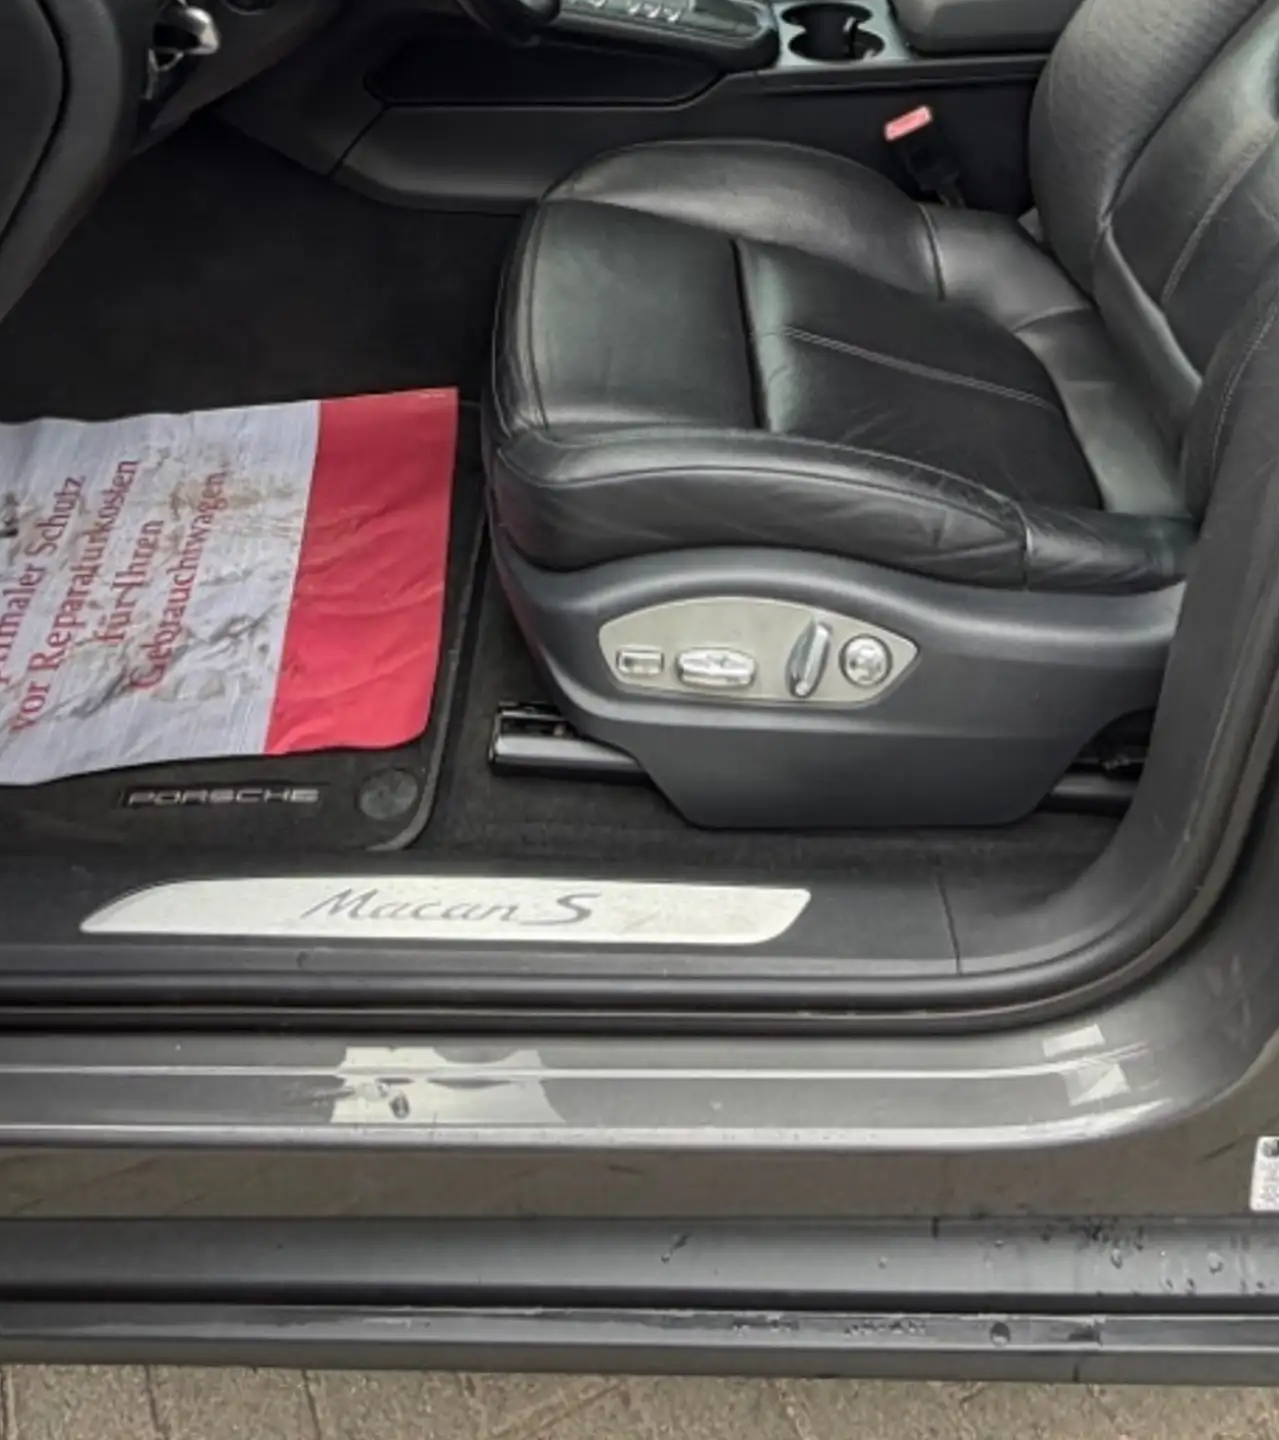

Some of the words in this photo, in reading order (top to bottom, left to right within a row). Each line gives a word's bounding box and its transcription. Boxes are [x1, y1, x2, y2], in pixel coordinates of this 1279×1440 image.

[25, 474, 87, 559] Schutz
[27, 459, 139, 672] Reparaturkosten
[111, 519, 165, 591] Ihren
[9, 681, 51, 733] vor
[128, 787, 320, 806] PORSCHE
[300, 887, 522, 922] Macan
[519, 891, 604, 926] S
